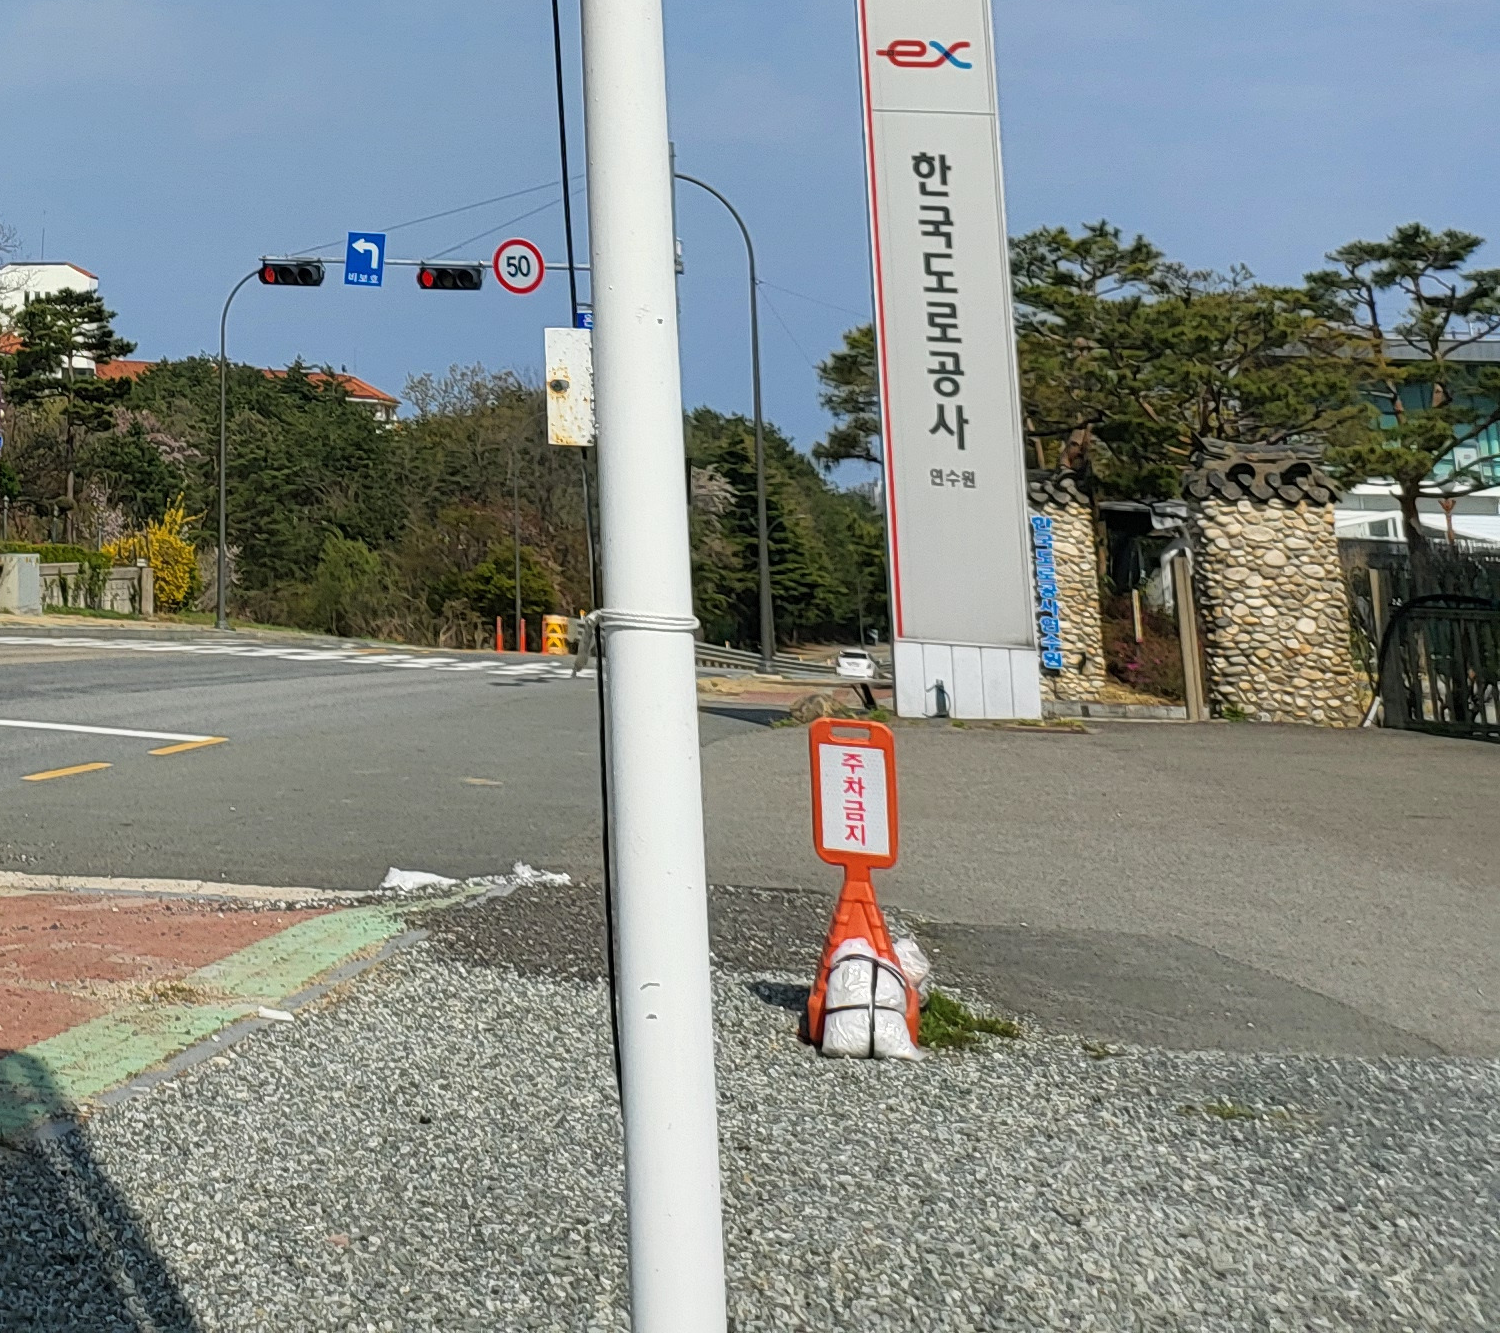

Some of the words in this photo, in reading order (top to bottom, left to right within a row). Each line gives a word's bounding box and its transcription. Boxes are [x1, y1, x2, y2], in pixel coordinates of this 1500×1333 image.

[875, 39, 973, 70] ex
[348, 272, 379, 284] 비보호
[506, 255, 531, 278] 50
[911, 152, 970, 451] 한국도로공사
[929, 468, 976, 489] 연수원
[840, 752, 867, 847] 주차금지
